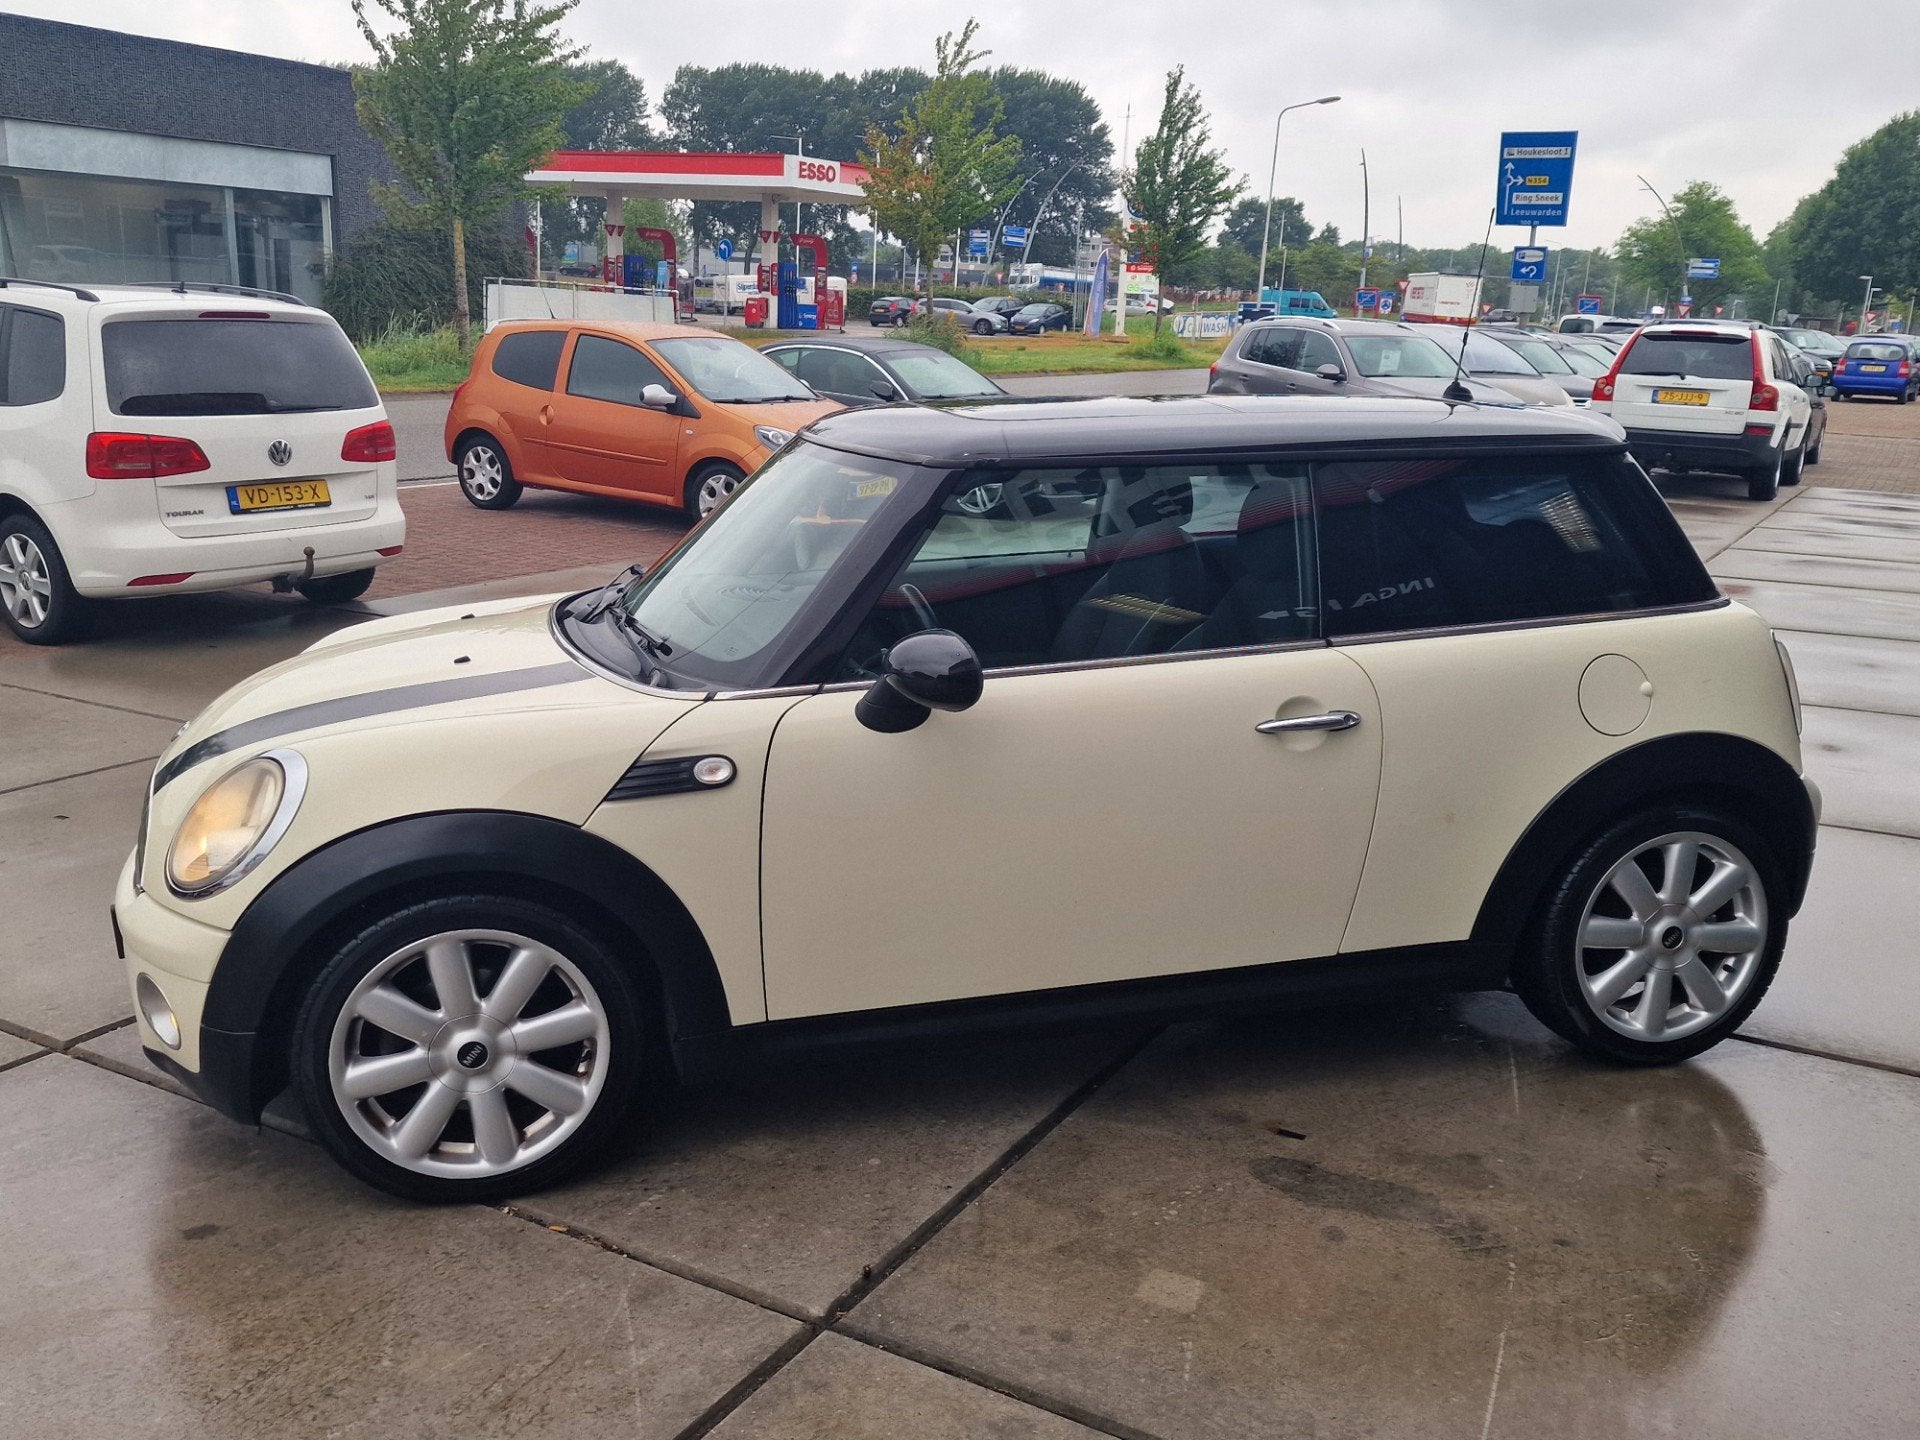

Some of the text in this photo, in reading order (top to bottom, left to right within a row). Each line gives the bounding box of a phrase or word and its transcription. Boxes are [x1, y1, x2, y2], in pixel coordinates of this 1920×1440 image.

[1516, 148, 1562, 156] Houkesloot
[798, 161, 836, 183] ESSO
[1515, 193, 1561, 203] Ring Sneek
[1510, 208, 1562, 216] Leeuwarden
[245, 484, 320, 504] VD-153-X
[165, 509, 204, 518] TOURAN
[462, 1045, 483, 1066] MINI
